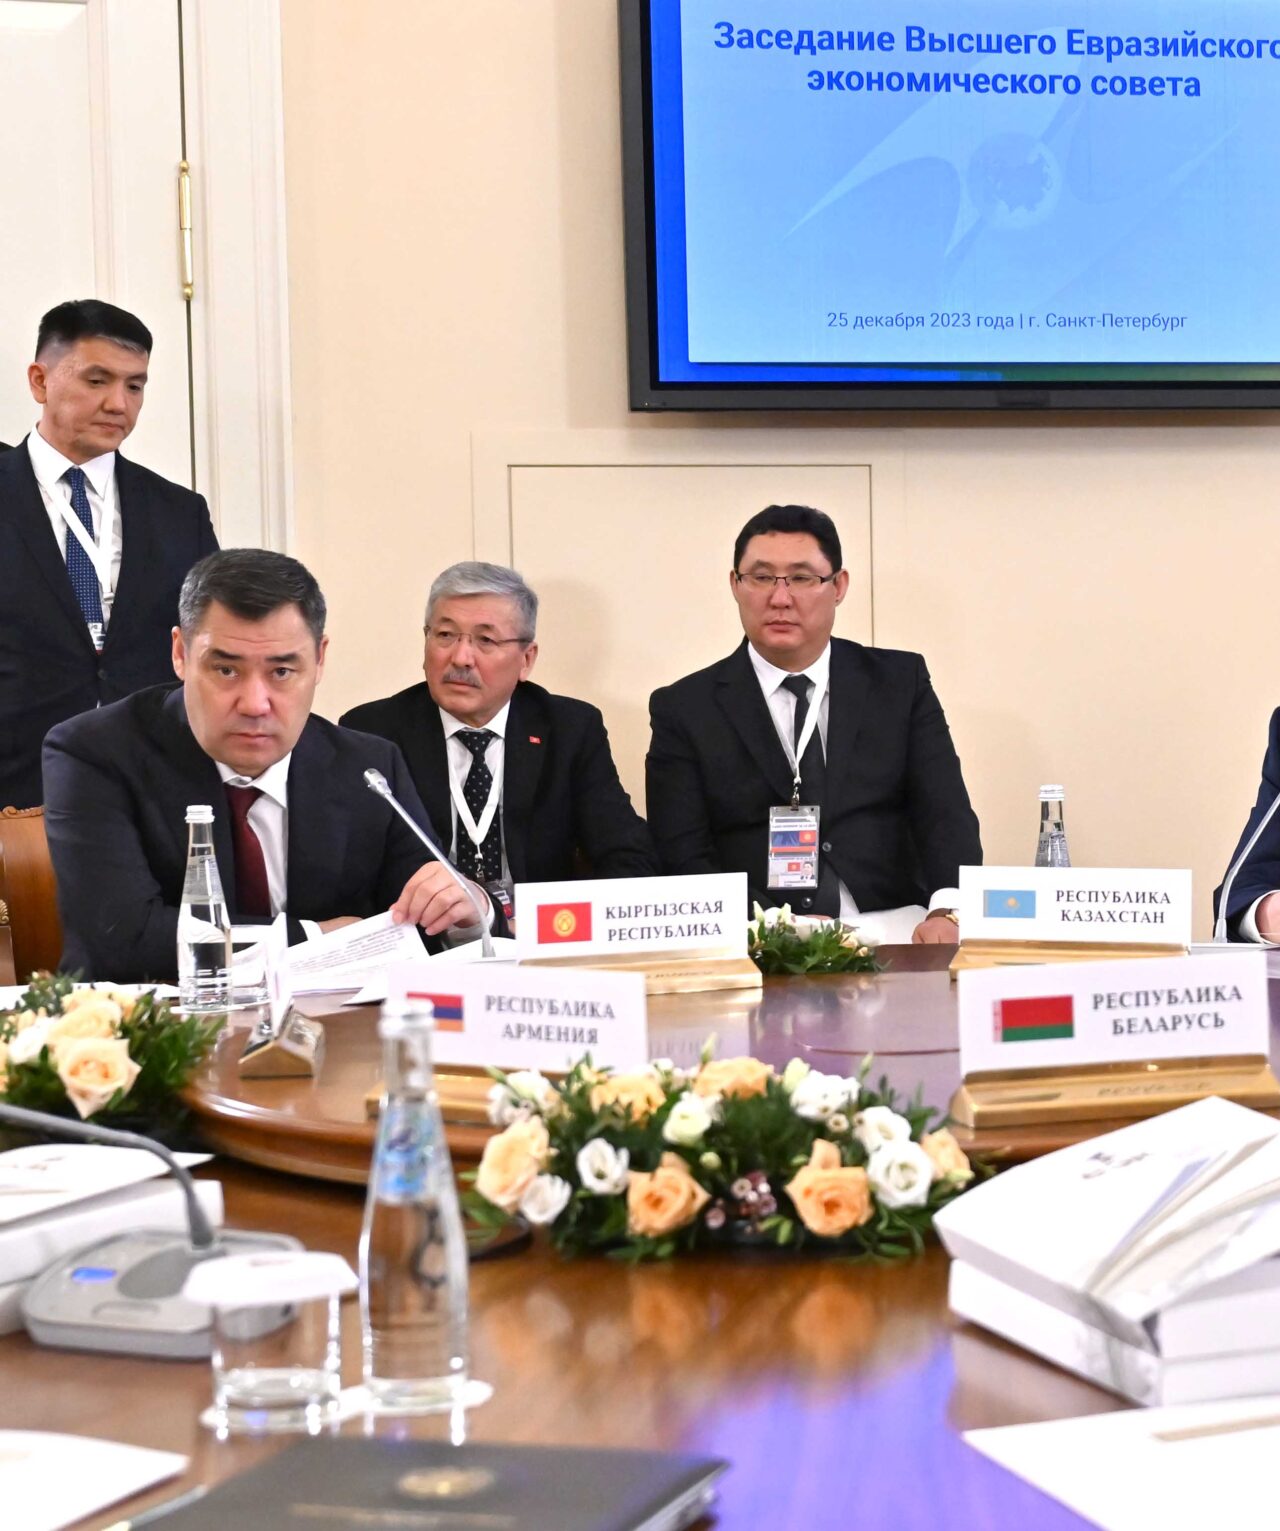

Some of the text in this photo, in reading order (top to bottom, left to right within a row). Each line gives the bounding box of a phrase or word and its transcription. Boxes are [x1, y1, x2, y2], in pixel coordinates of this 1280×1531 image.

[713, 21, 896, 55] Заседание
[905, 25, 1057, 56] Высшего
[807, 69, 1201, 97] экономического совета
[827, 312, 849, 328] 25
[852, 311, 925, 331] декабря
[929, 312, 971, 328] 2023
[976, 315, 1015, 331] года
[1028, 315, 1041, 328] г.
[1045, 312, 1188, 332] Санкт-Петербург
[1055, 889, 1171, 905] РЕСПУБЛИКА
[605, 900, 723, 920] КЫРГЫЗСКАЯ
[1061, 909, 1165, 924] КАЗАХСТАН
[607, 922, 722, 942] РЕСПУБЛИКА
[484, 994, 616, 1020] РЕСПУБЛИКА
[1092, 985, 1243, 1011] РЕСПУБЛИКА
[501, 1022, 599, 1045] АРМЕНИЯ
[1112, 1011, 1226, 1036] БЕЛАРУСЬ
